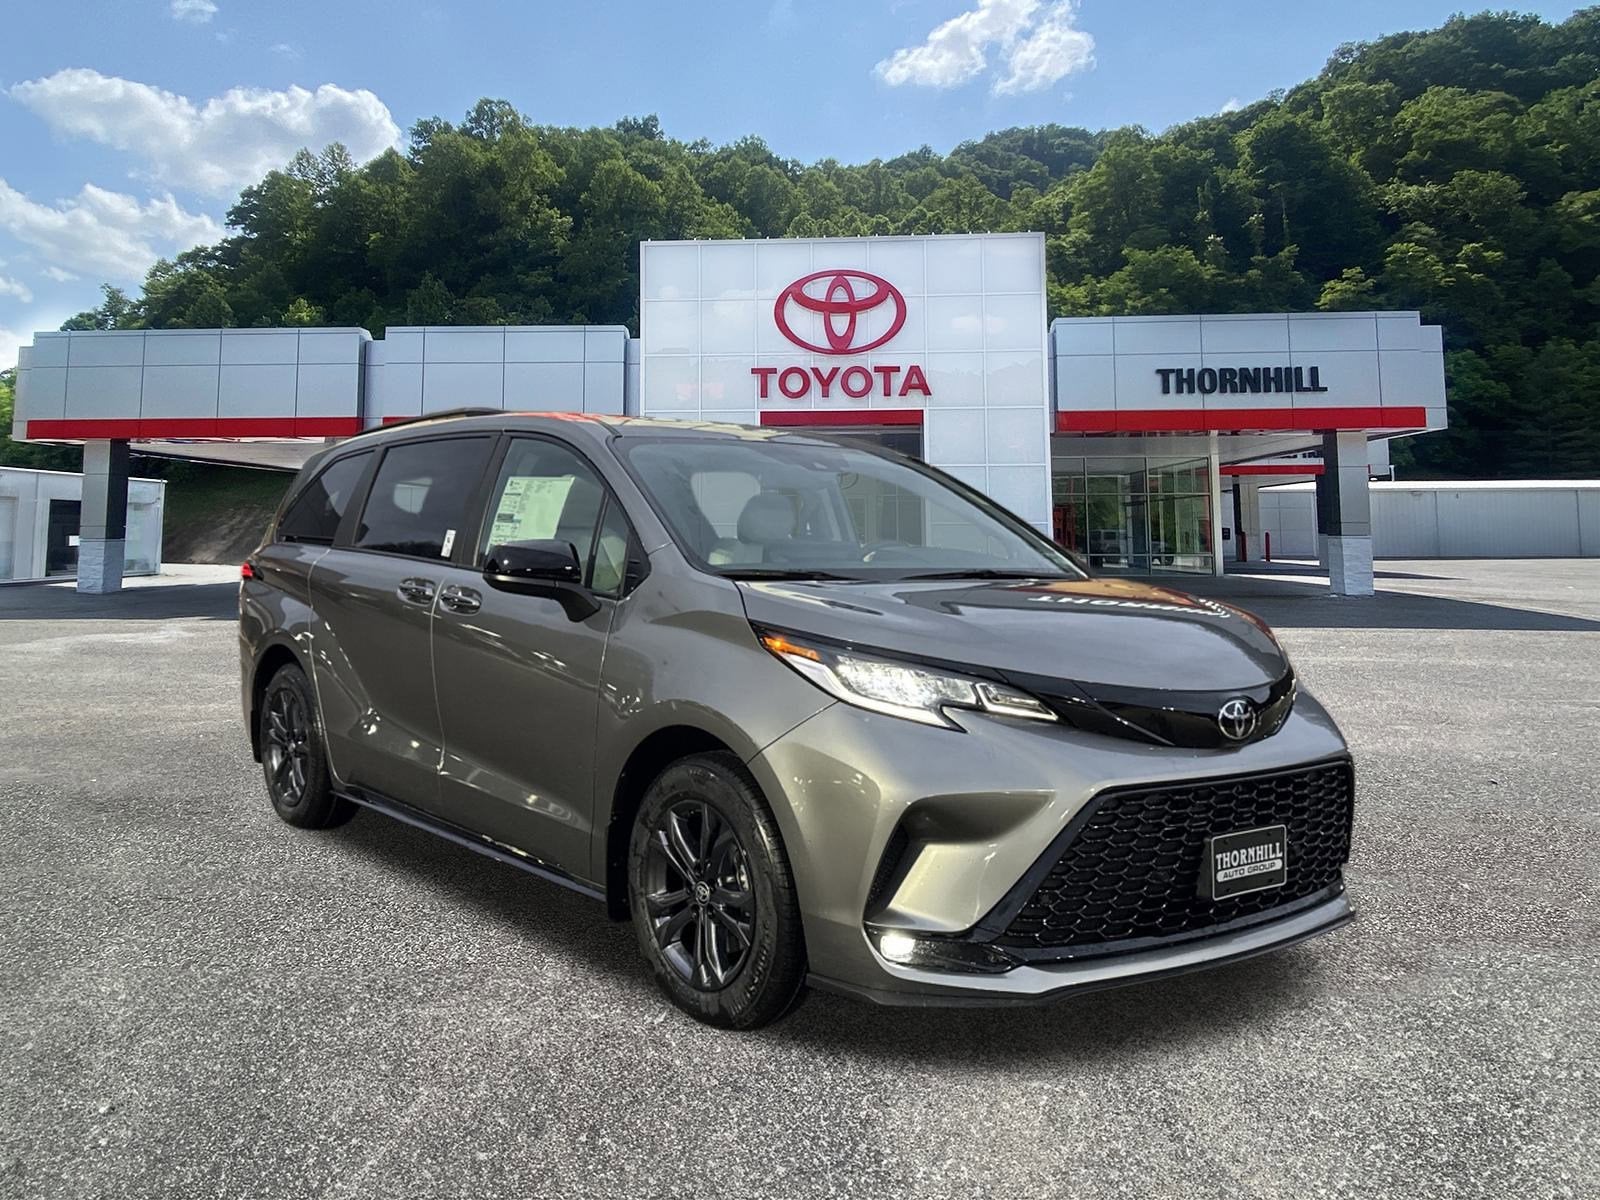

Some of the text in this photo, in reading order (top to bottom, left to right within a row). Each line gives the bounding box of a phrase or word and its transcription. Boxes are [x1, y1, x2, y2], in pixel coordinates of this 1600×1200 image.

[751, 365, 932, 399] TOYOTA
[1156, 366, 1328, 394] THORNHILL
[1215, 842, 1283, 870] THORNHILL
[1222, 862, 1276, 880] AUTO GROUP
